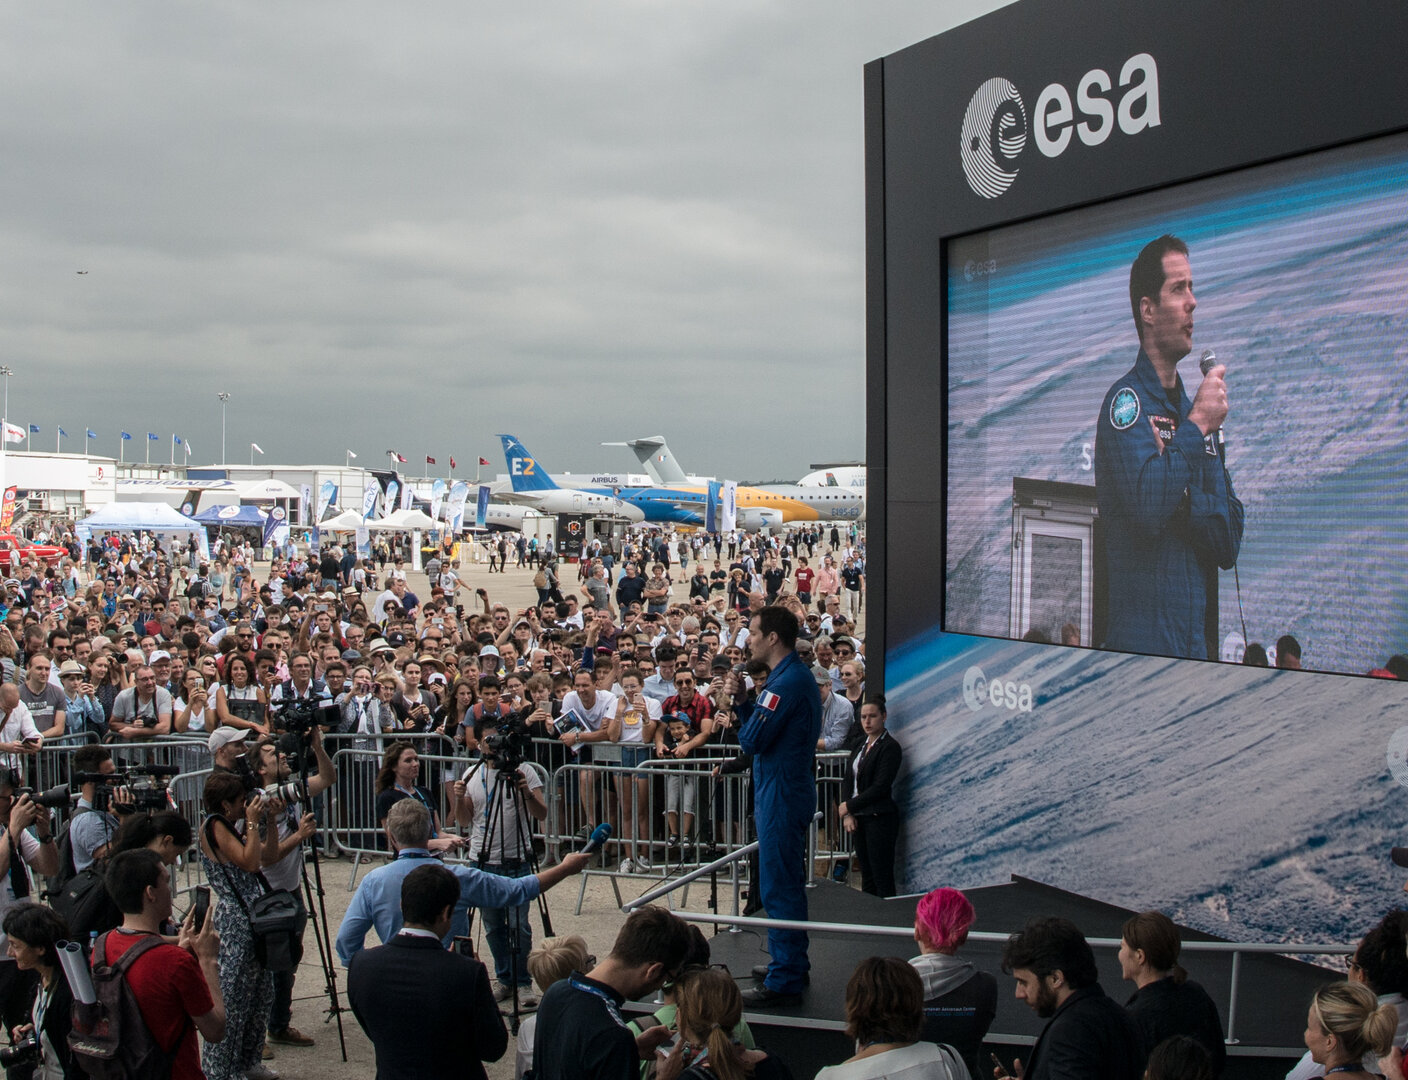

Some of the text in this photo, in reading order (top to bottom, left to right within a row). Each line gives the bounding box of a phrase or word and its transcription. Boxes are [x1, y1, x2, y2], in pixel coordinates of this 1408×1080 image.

[1033, 53, 1161, 158] esa
[511, 457, 535, 476] E2
[591, 476, 618, 484] AIRBUS
[989, 679, 1032, 712] esa
